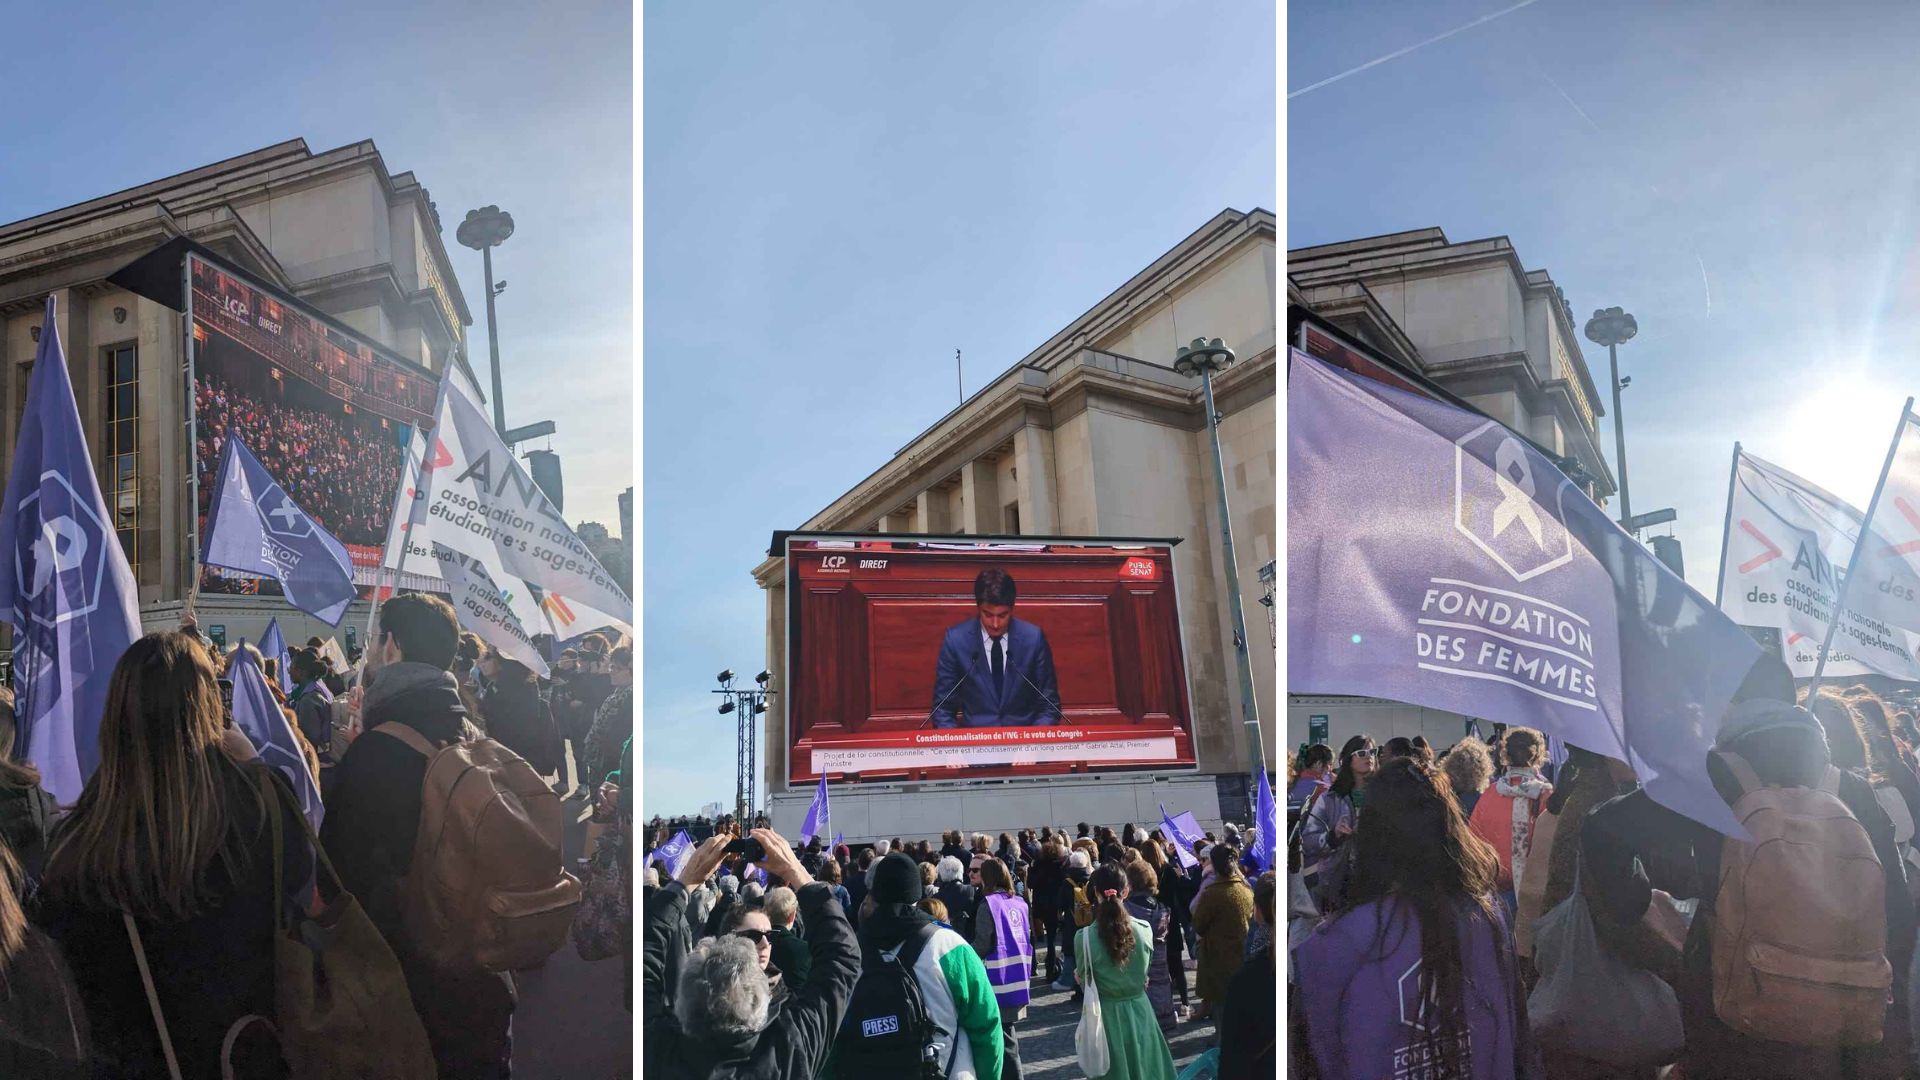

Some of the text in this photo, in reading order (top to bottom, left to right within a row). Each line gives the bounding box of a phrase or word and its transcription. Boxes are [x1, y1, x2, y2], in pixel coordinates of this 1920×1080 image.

[258, 316, 282, 336] DIRECT
[441, 488, 535, 534] association
[821, 556, 847, 568] LCP
[860, 560, 888, 569] DIRECT
[1746, 586, 1778, 604] des
[1421, 589, 1593, 657] FONDATION
[1847, 609, 1892, 638] nationale
[1416, 632, 1597, 698] DES FEMMES
[1796, 651, 1814, 663] des
[916, 732, 992, 743] Constitutionnalisation
[993, 732, 1002, 740] de
[1003, 731, 1018, 740] l'IVG
[1024, 731, 1031, 739] le
[1031, 731, 1046, 739] vote
[1047, 730, 1056, 738] du
[1056, 729, 1083, 739] Congrès
[824, 752, 845, 761] Projet
[847, 751, 855, 759] de
[857, 751, 867, 759] loi
[868, 749, 925, 758] constitutionnelle
[972, 746, 1023, 754] l'aboutissement
[1040, 744, 1054, 752] long
[824, 760, 852, 768] ministre
[865, 1017, 896, 1035] PRESS
